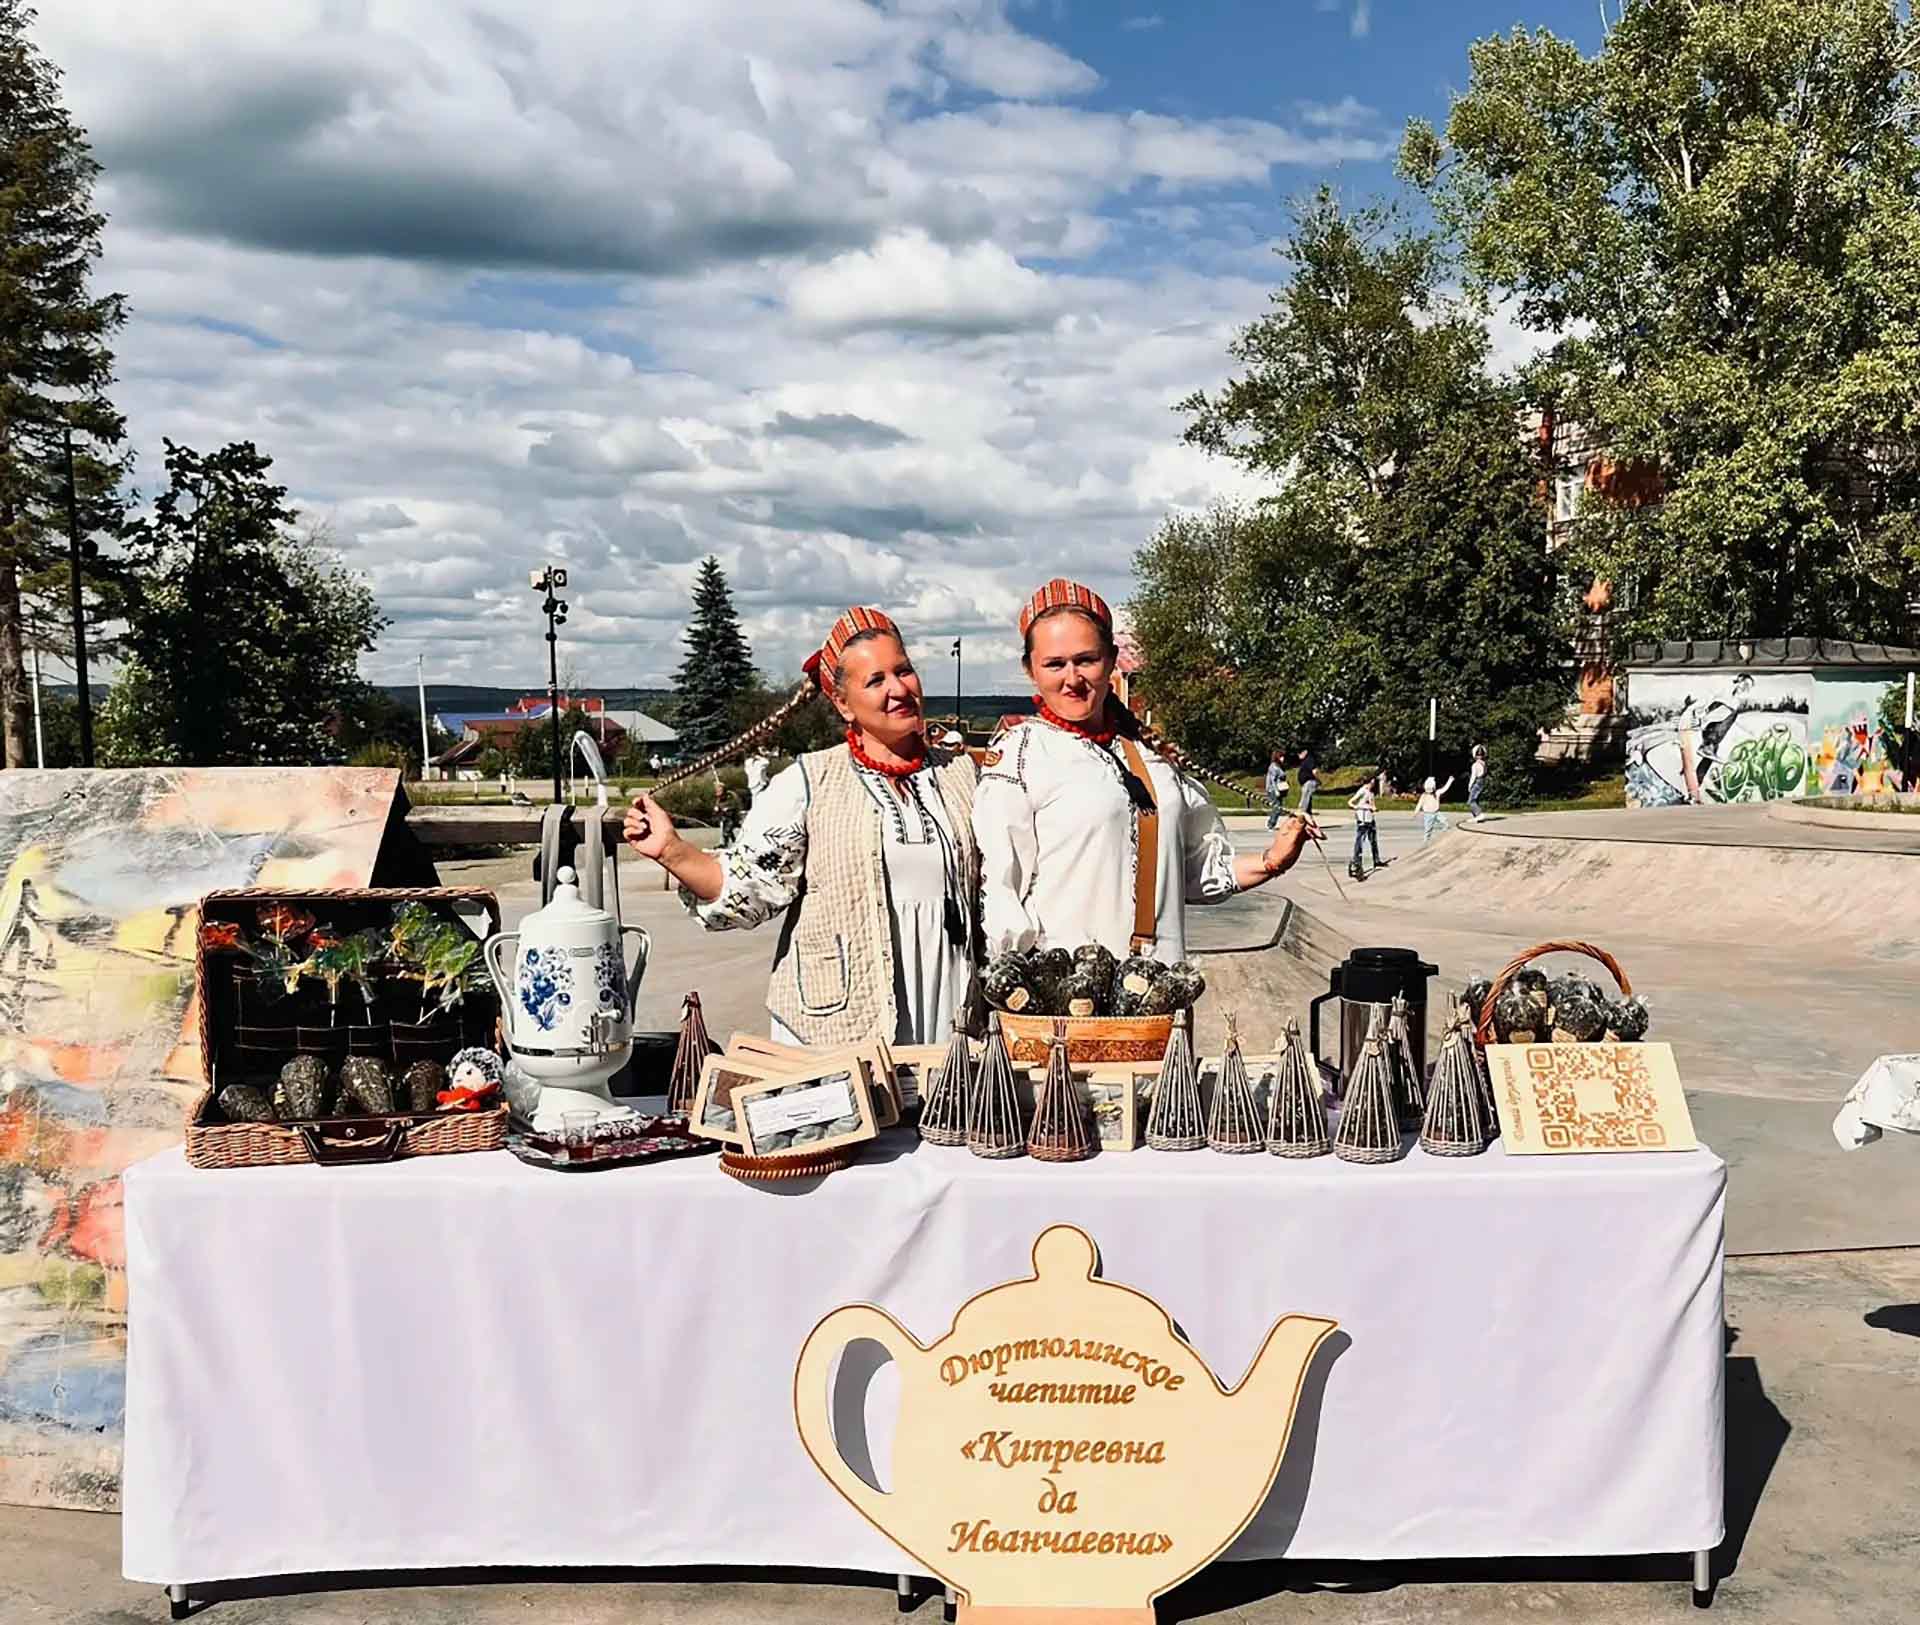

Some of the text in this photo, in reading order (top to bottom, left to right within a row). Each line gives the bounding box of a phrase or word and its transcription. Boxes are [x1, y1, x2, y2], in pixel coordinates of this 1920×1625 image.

[940, 1337, 1185, 1391] Дюртюлинское
[988, 1381, 1137, 1405] чаепитие
[961, 1431, 1166, 1474] «Кипреевна
[1037, 1478, 1078, 1514] да
[948, 1520, 1174, 1555] Иванчаевна»
